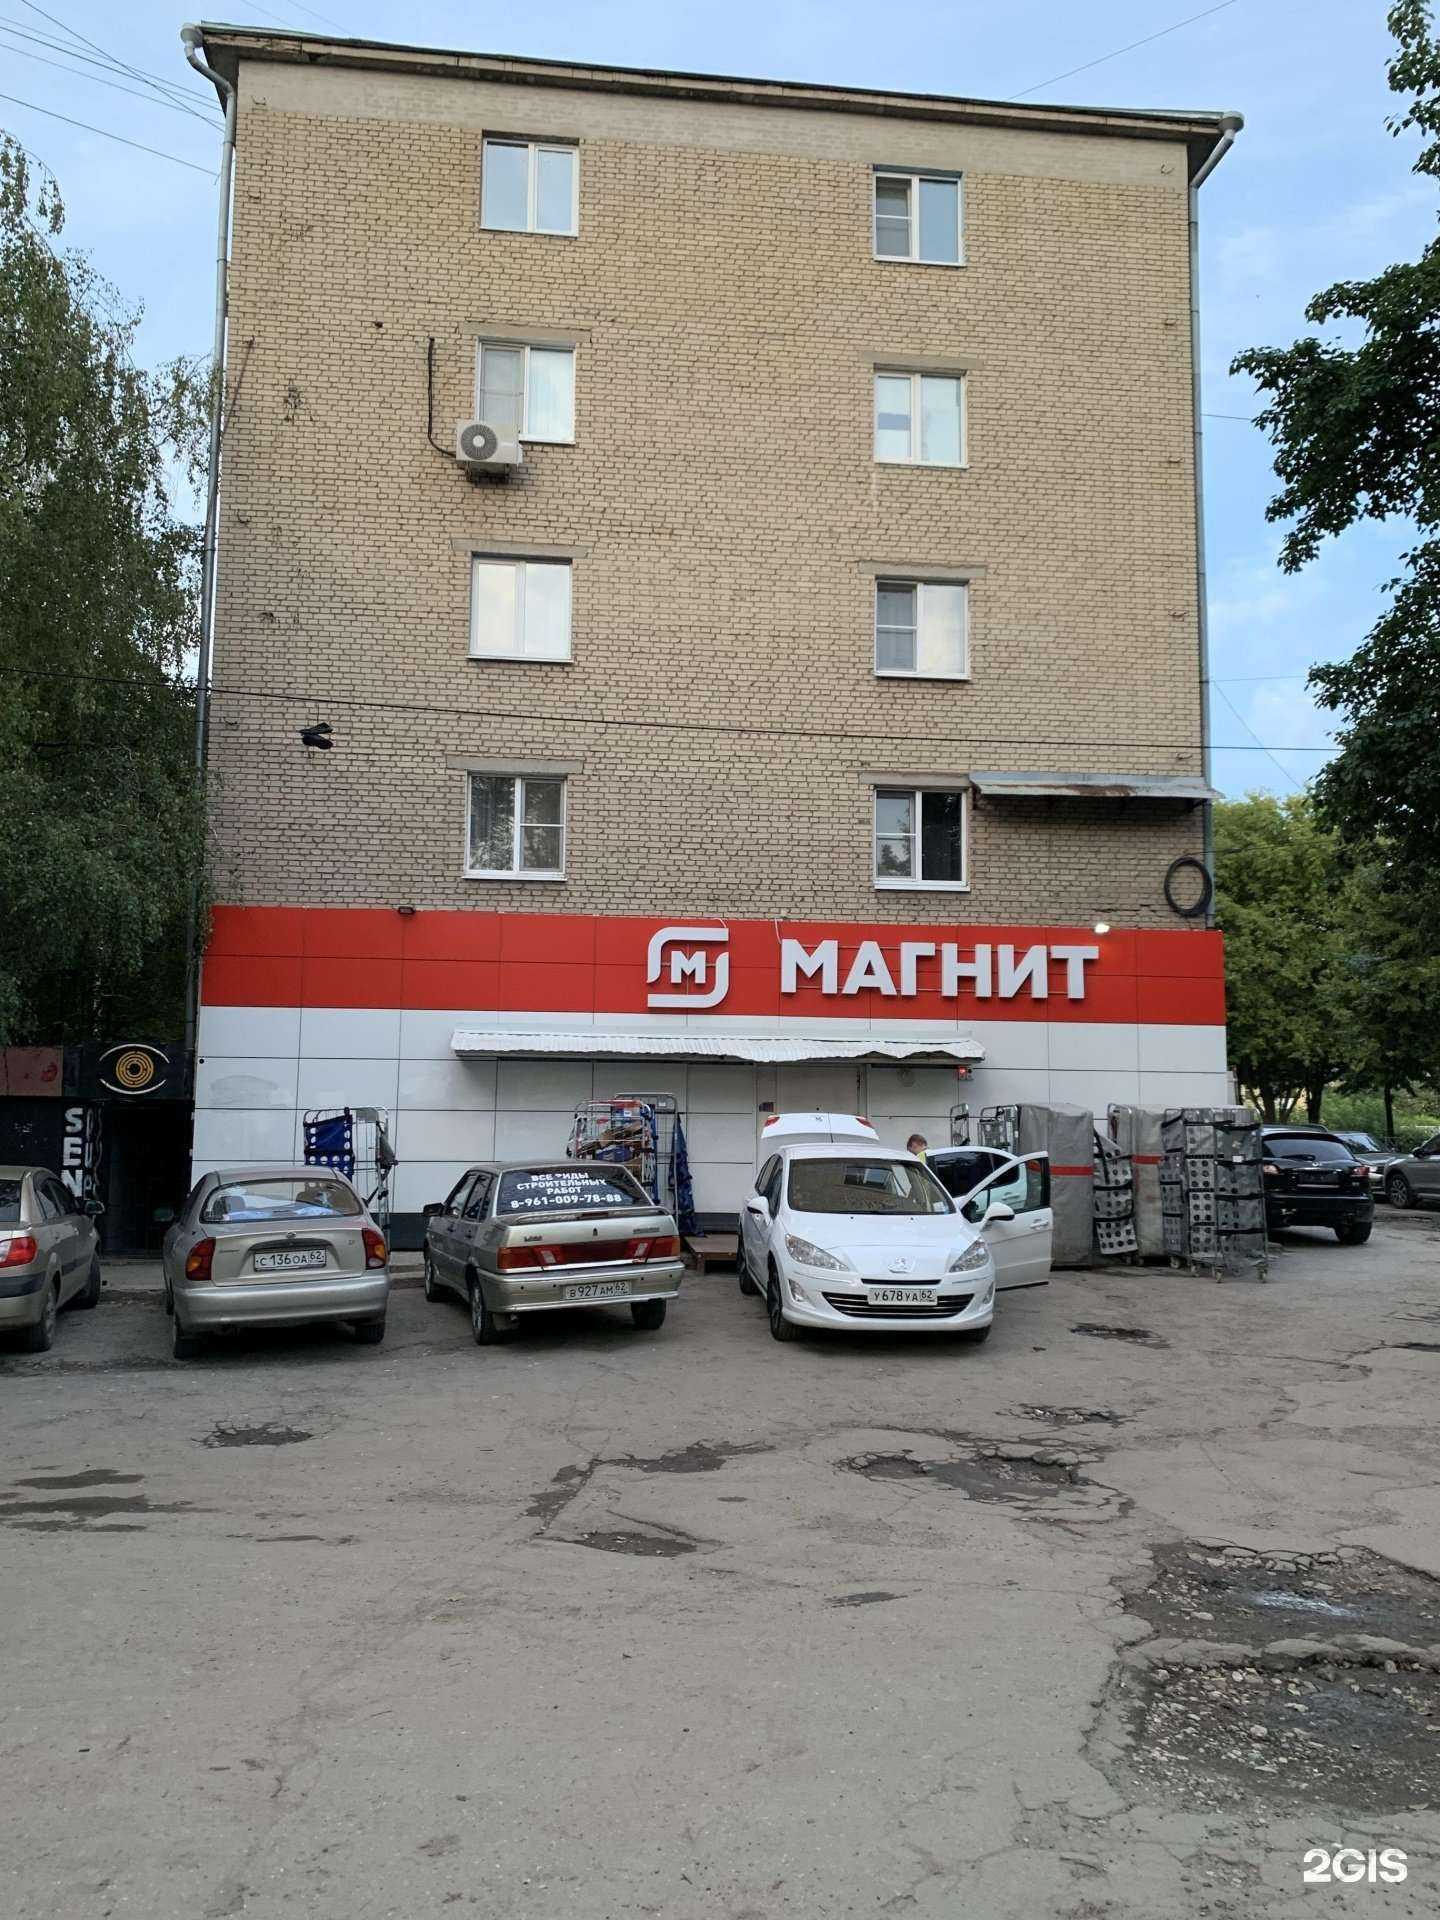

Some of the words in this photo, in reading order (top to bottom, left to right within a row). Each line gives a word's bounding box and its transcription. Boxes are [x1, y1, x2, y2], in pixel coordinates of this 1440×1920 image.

[780, 938, 1100, 1000] МАГНИТ
[530, 1173, 553, 1182] ВСЕ
[516, 1178, 608, 1191] СТРОИТЕЛЬНЫХ
[546, 1186, 582, 1195] РАБОТ
[510, 1194, 623, 1209] 8-961-009-78-88
